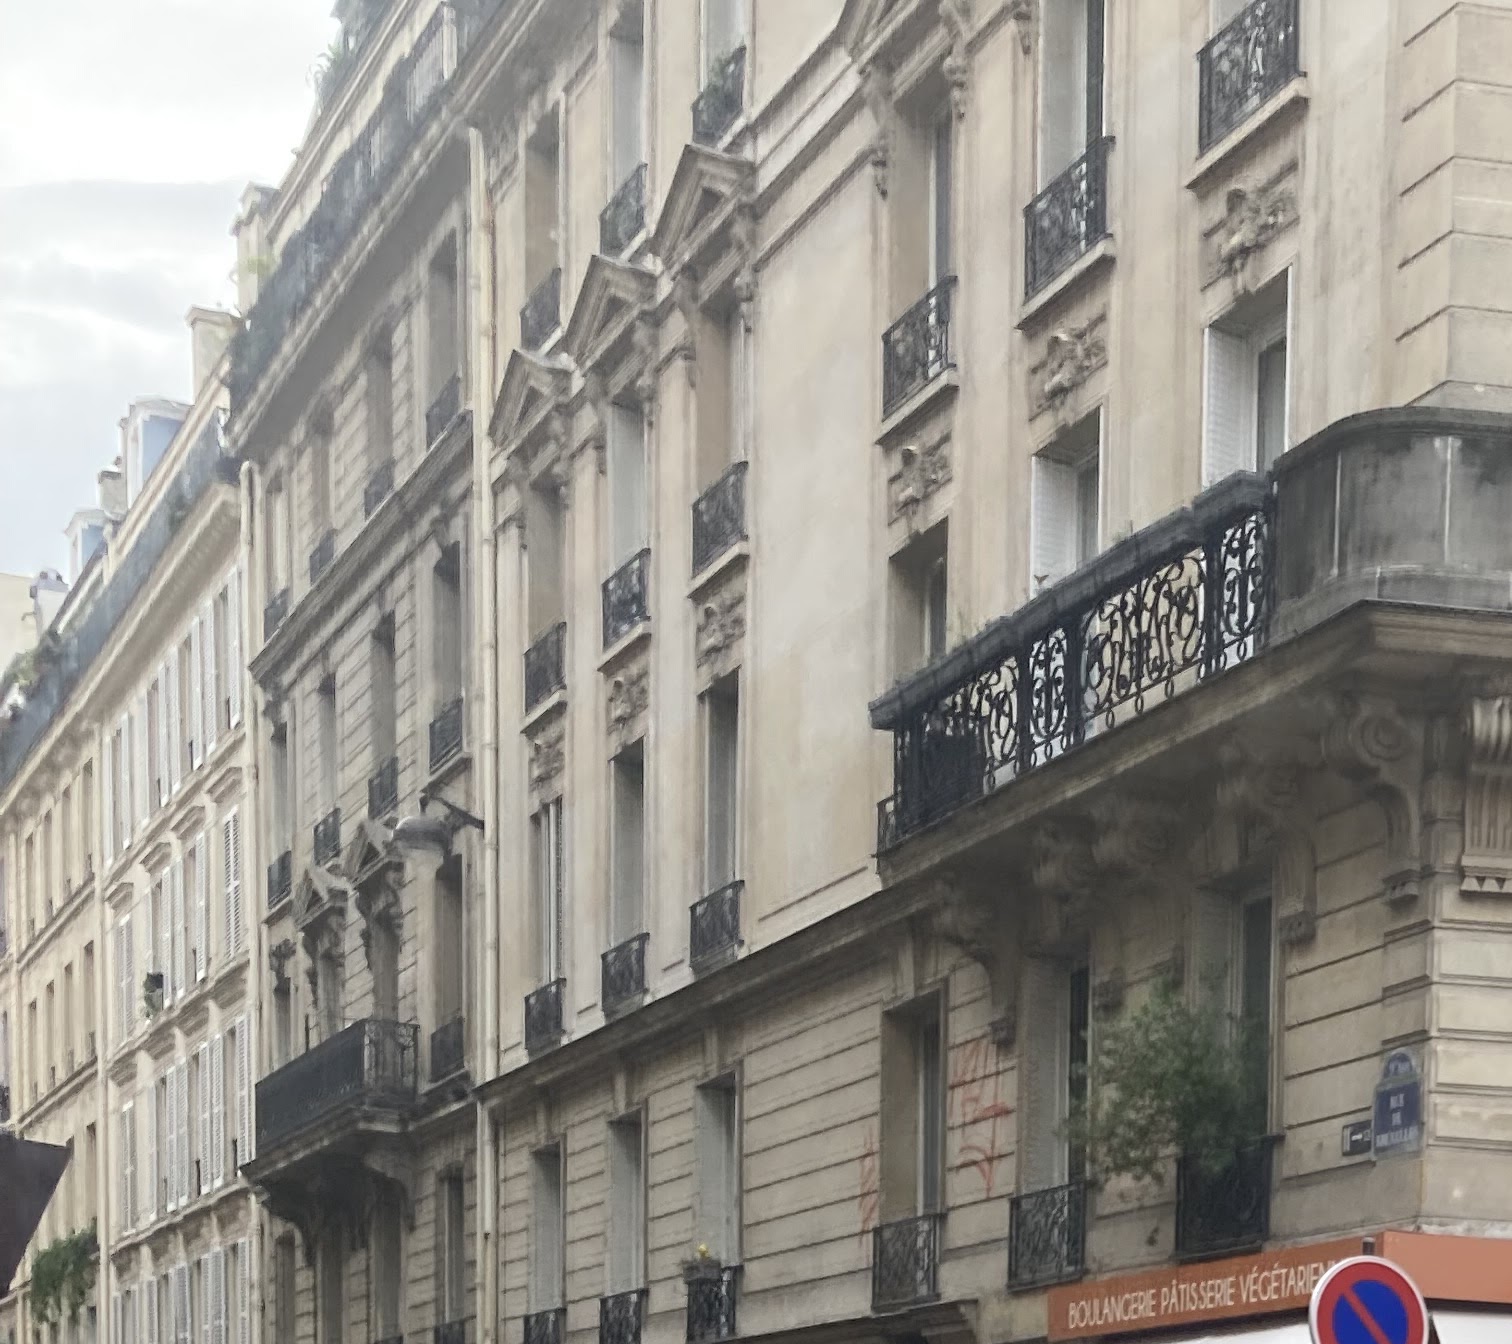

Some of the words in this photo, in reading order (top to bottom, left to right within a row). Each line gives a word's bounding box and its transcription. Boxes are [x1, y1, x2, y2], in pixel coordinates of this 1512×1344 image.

[1068, 1288, 1156, 1329] BOULANGERIE
[1160, 1275, 1238, 1315] PÂTISSERIE
[1239, 1261, 1335, 1303] VÉGÉTARIE
